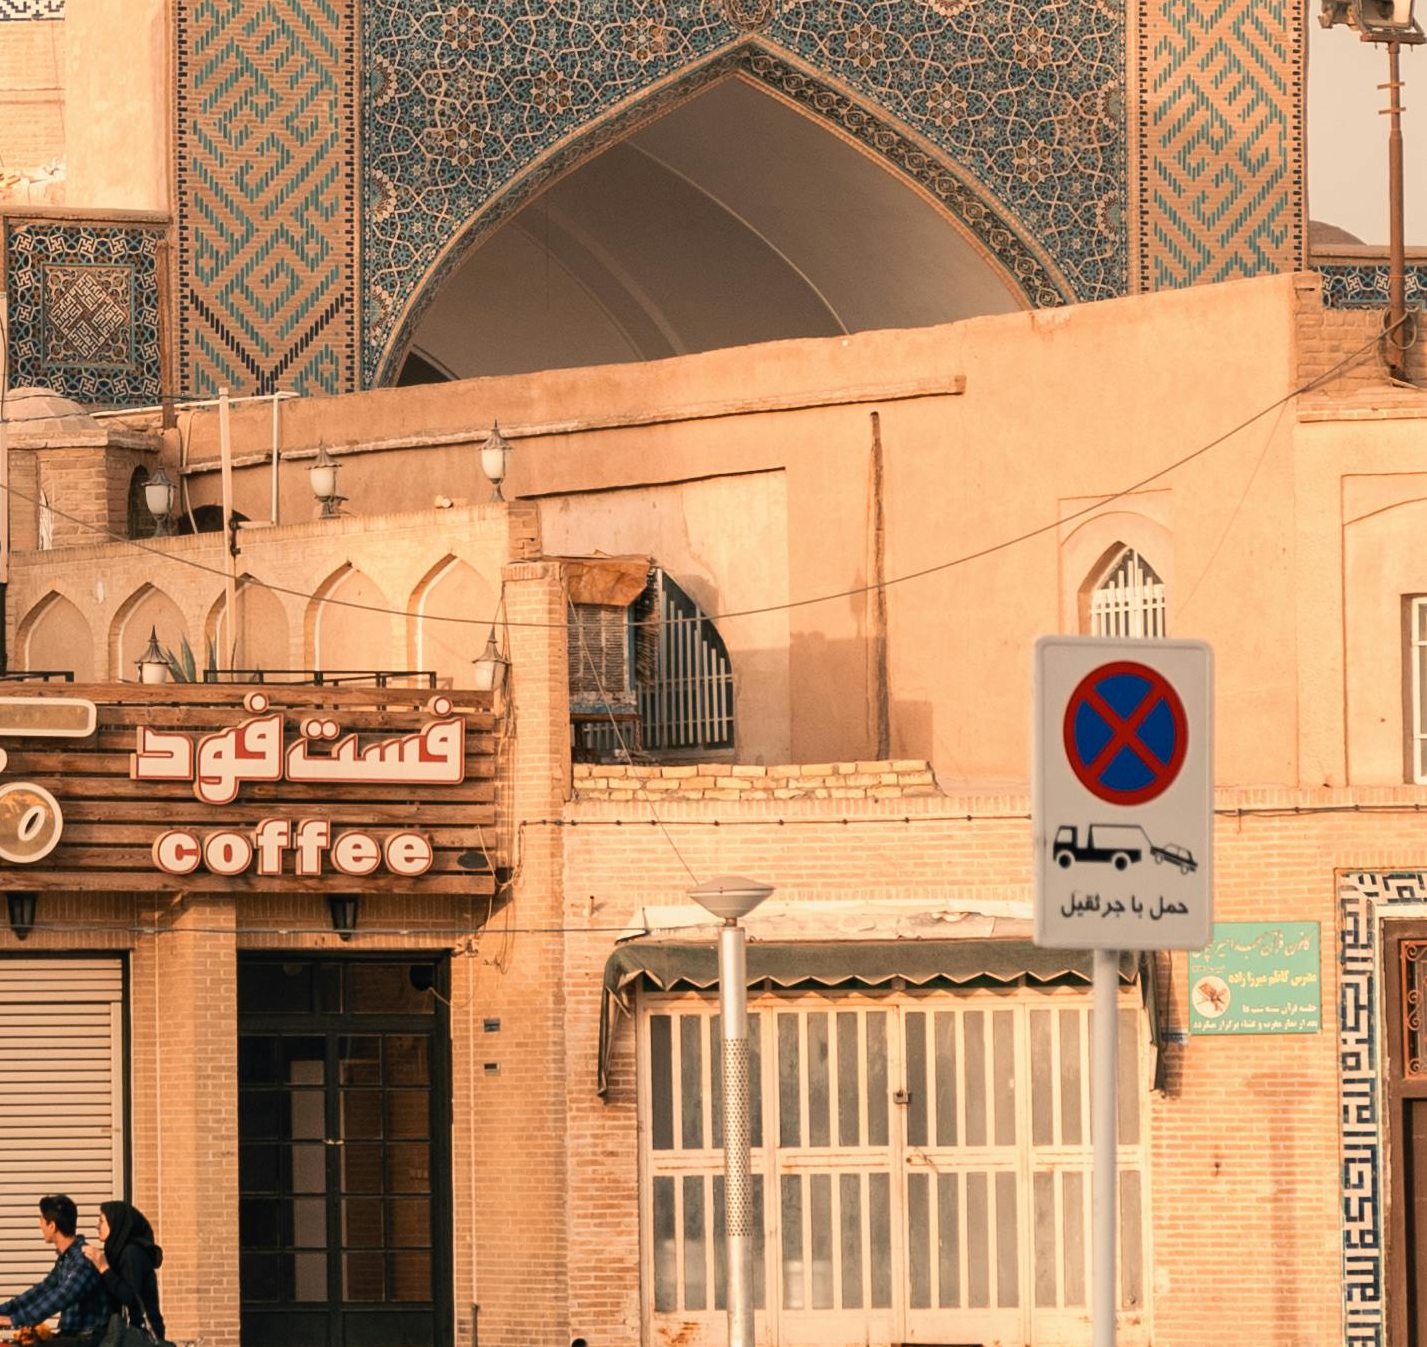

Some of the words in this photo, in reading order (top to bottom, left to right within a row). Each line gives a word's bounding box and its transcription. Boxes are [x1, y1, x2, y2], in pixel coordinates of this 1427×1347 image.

[131, 691, 284, 804] فود
[286, 695, 465, 784] فست
[152, 818, 433, 876] coffee
[1131, 894, 1144, 919] با
[1149, 895, 1189, 920] حمل
